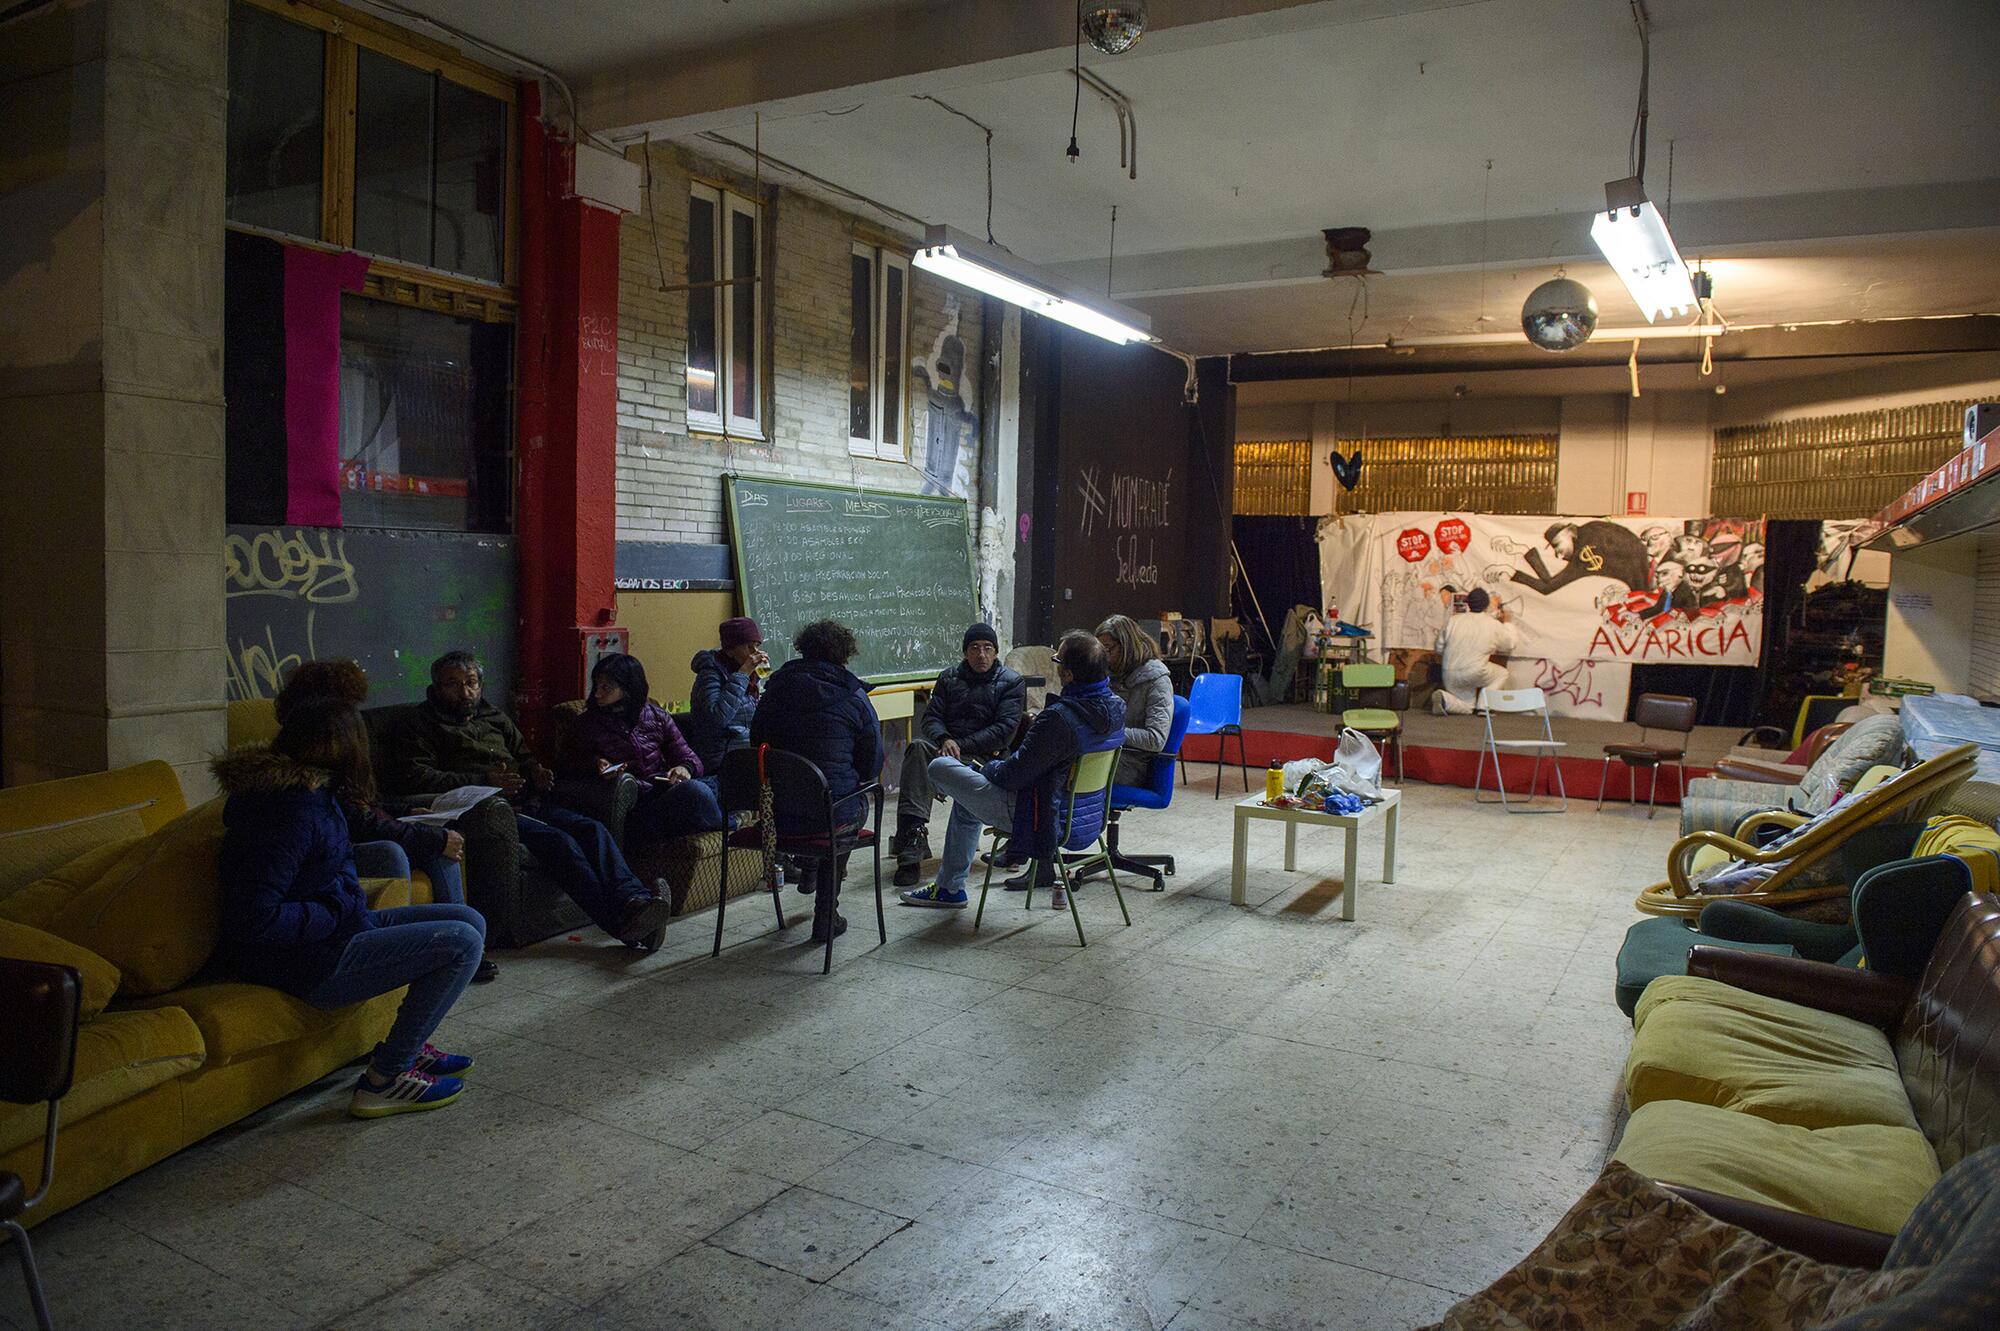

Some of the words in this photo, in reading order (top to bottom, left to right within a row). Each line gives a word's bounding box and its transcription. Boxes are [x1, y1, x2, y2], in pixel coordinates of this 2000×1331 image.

[1440, 525, 1465, 537] STOP
[1401, 534, 1425, 547] STOP
[1588, 618, 1752, 660] AVARICIA
